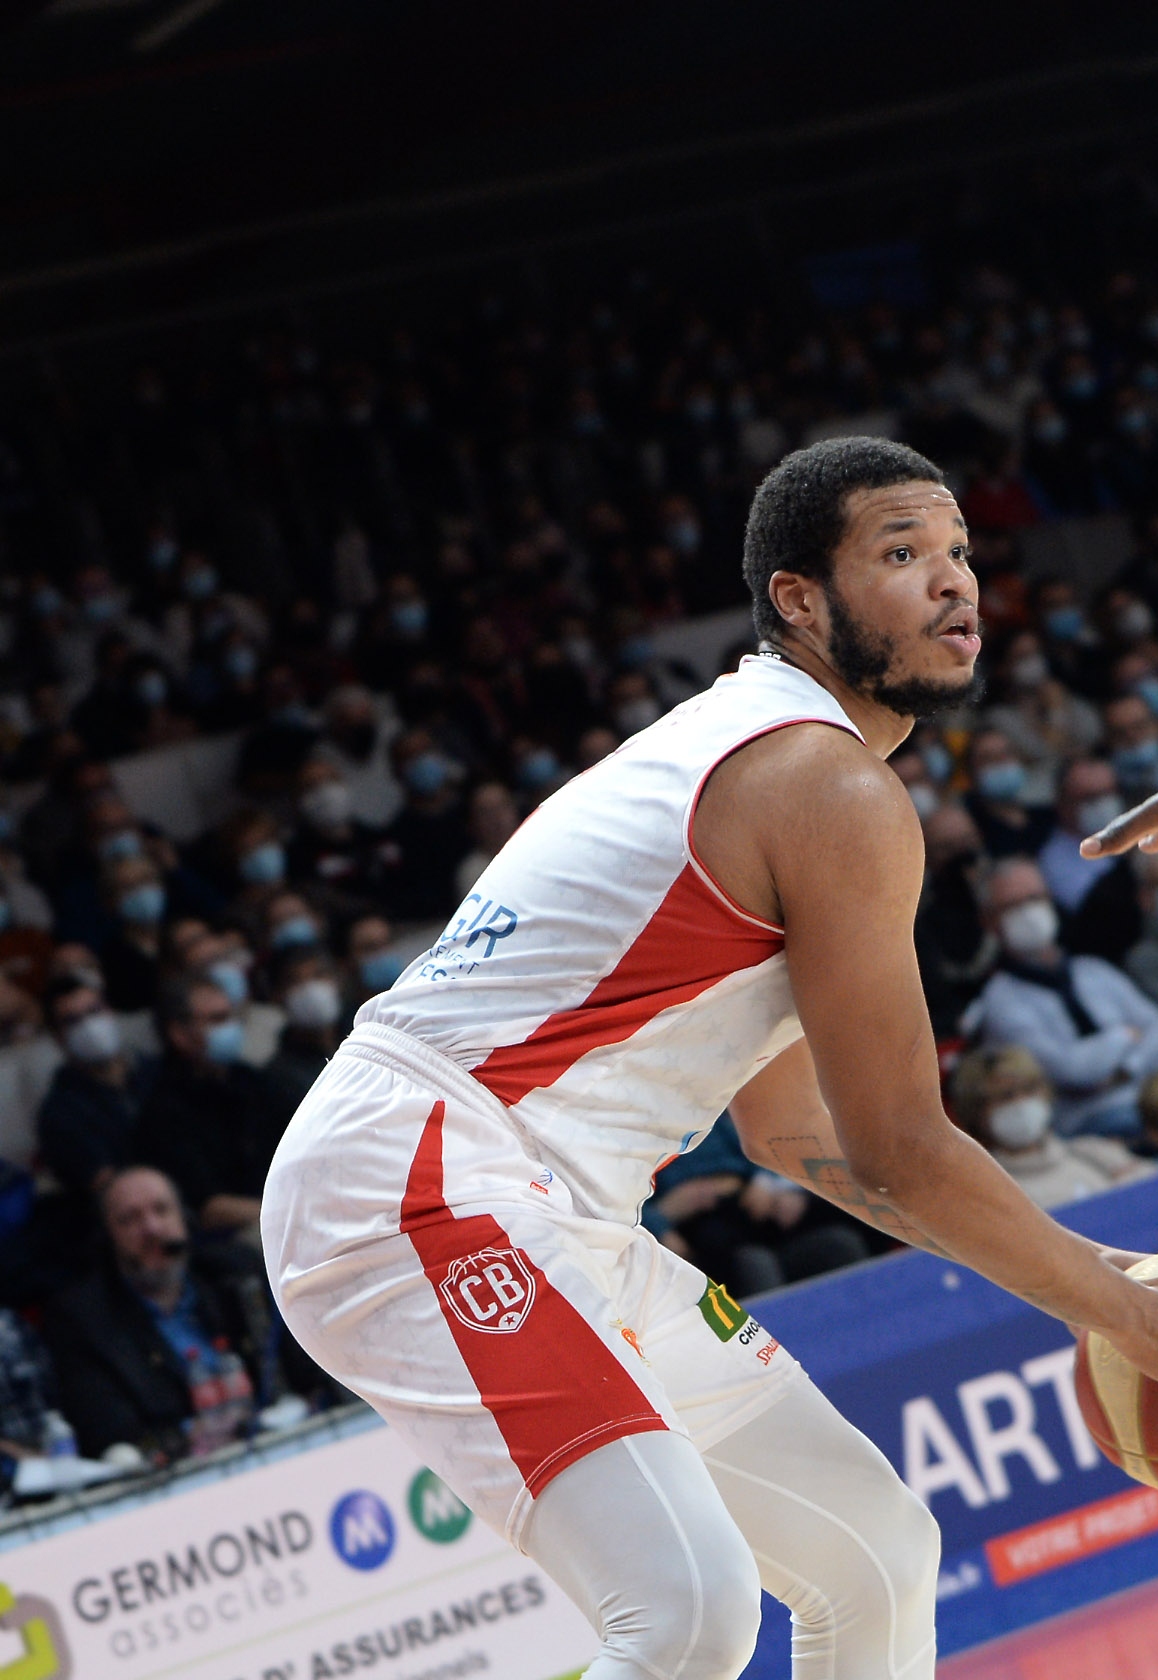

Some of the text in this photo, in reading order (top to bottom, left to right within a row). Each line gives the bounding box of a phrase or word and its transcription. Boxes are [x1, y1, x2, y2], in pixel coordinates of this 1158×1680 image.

[458, 1262, 526, 1321] CB
[739, 1319, 761, 1345] CHO
[73, 1508, 314, 1625] GERMOND
[309, 1575, 547, 1680] ASSURANCES
